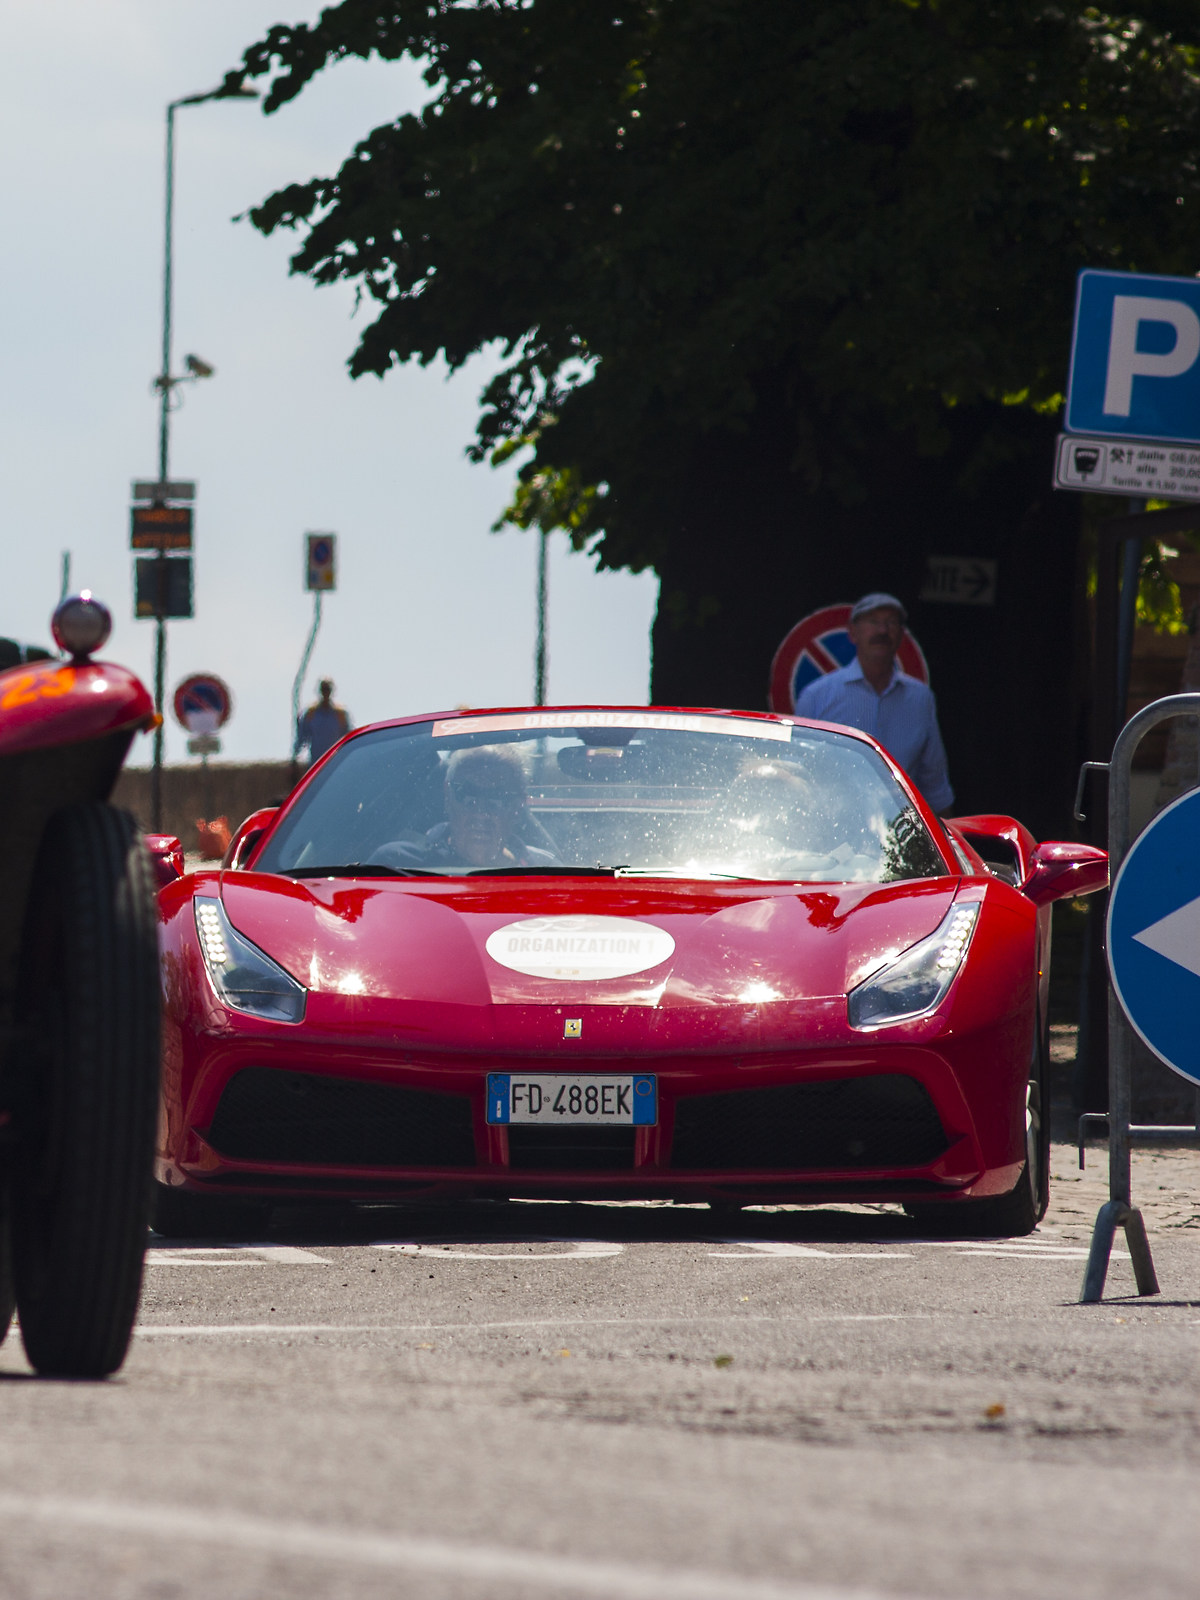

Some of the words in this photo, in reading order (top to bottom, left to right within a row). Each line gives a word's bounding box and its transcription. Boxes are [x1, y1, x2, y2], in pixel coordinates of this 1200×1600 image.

[1103, 295, 1200, 417] P
[524, 712, 702, 730] ORGANIZATION
[507, 936, 641, 955] ORGANIZATION
[511, 1083, 543, 1115] FD
[552, 1084, 632, 1115] 488EK
